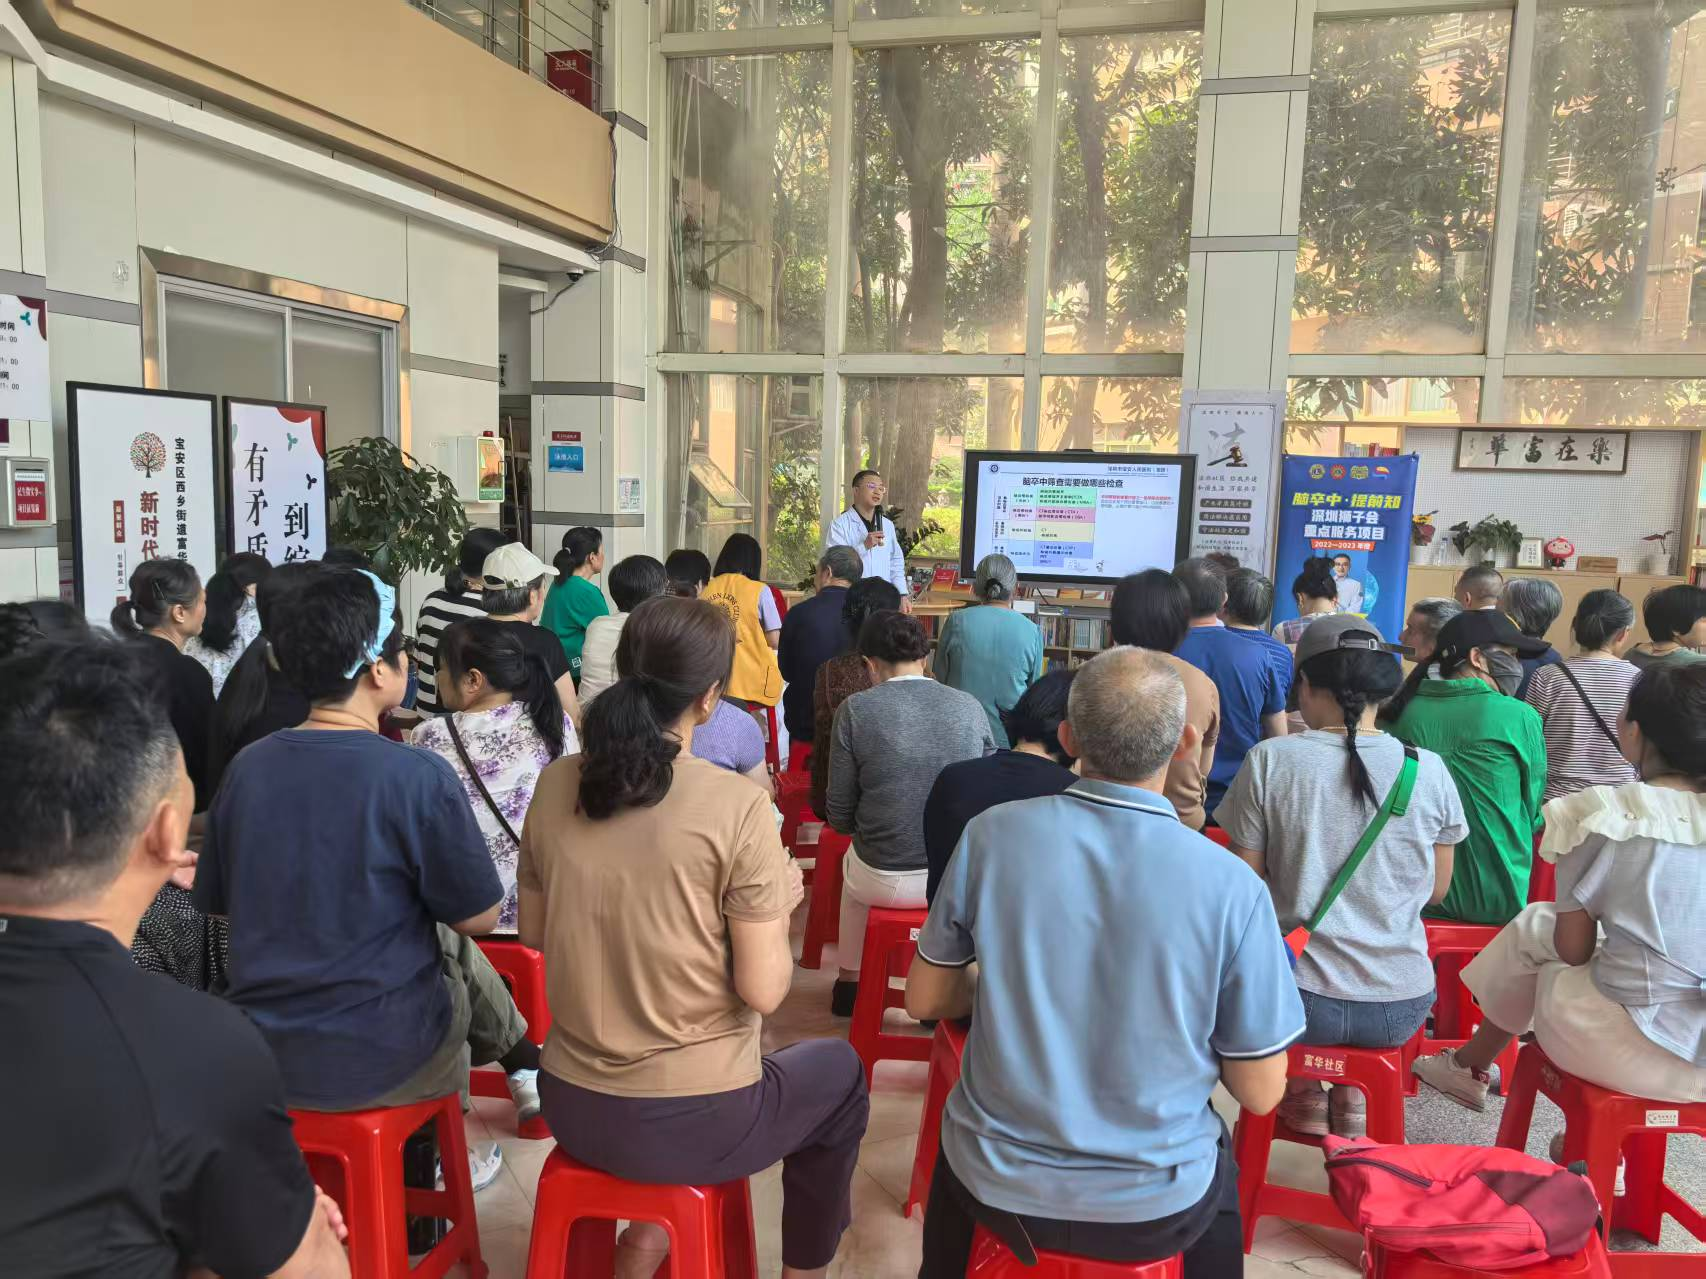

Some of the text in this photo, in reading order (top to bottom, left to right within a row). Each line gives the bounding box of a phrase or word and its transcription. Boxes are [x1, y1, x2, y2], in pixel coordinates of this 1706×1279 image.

[1311, 509, 1379, 524] 深圳狮子会
[1304, 524, 1385, 540] 重点服务项目
[1304, 1054, 1345, 1073] 富华社区
